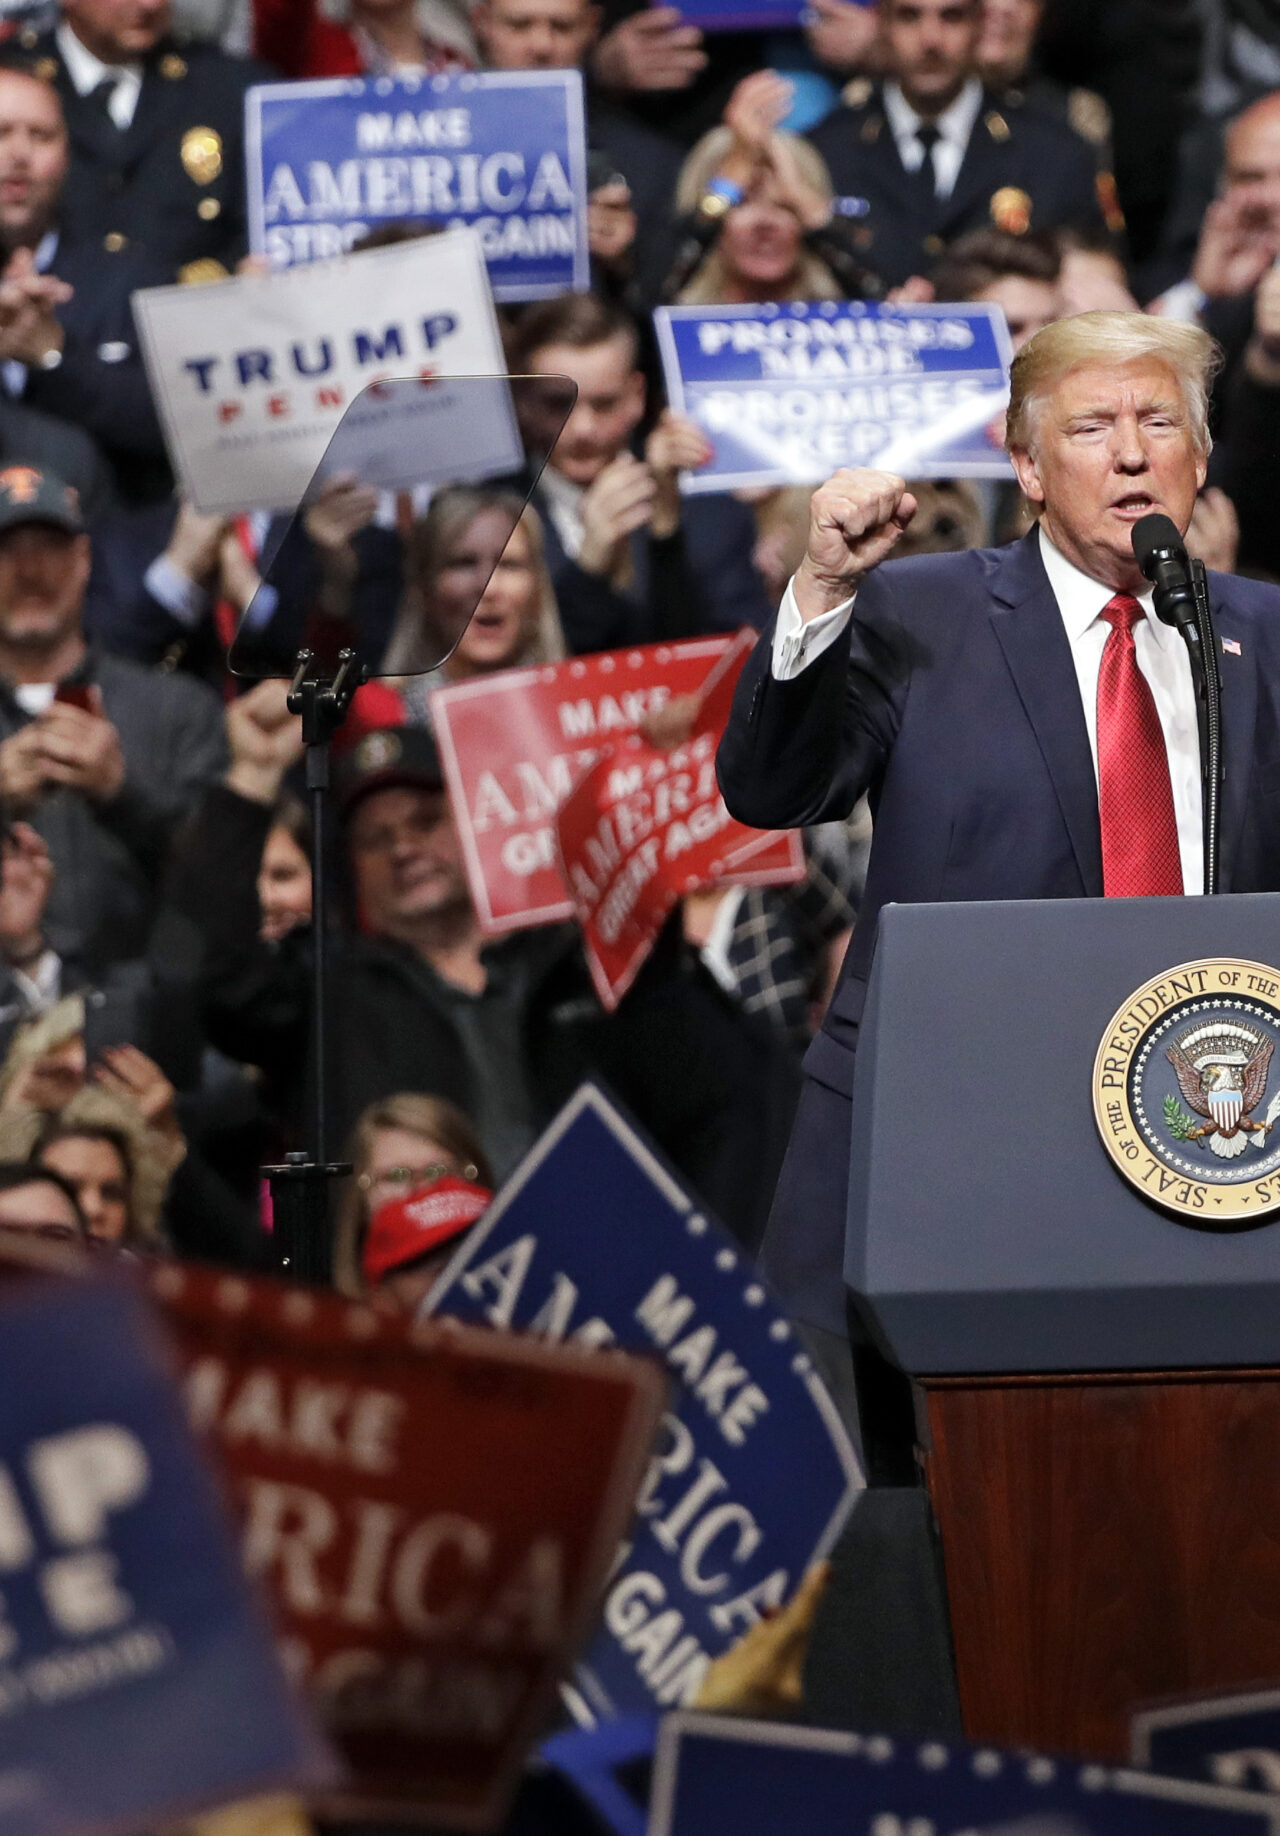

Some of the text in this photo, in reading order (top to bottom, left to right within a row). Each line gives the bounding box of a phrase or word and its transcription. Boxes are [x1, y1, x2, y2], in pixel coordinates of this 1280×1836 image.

[356, 108, 472, 151] MAKE
[264, 151, 575, 222] AMERICA
[266, 221, 371, 267] STR
[183, 310, 459, 393] TRUMP
[698, 317, 976, 356] PROMISES
[761, 344, 925, 378] MADE
[218, 361, 444, 424] PENCE
[1218, 970, 1241, 986] OF
[1247, 973, 1279, 998] THE
[1101, 969, 1209, 1090] PRESIDENT
[1106, 1099, 1128, 1136] THE
[1118, 1138, 1140, 1160] OF
[1142, 1157, 1208, 1208] SEAL
[634, 1273, 770, 1447] MAKE
[241, 1477, 565, 1645] RICA
